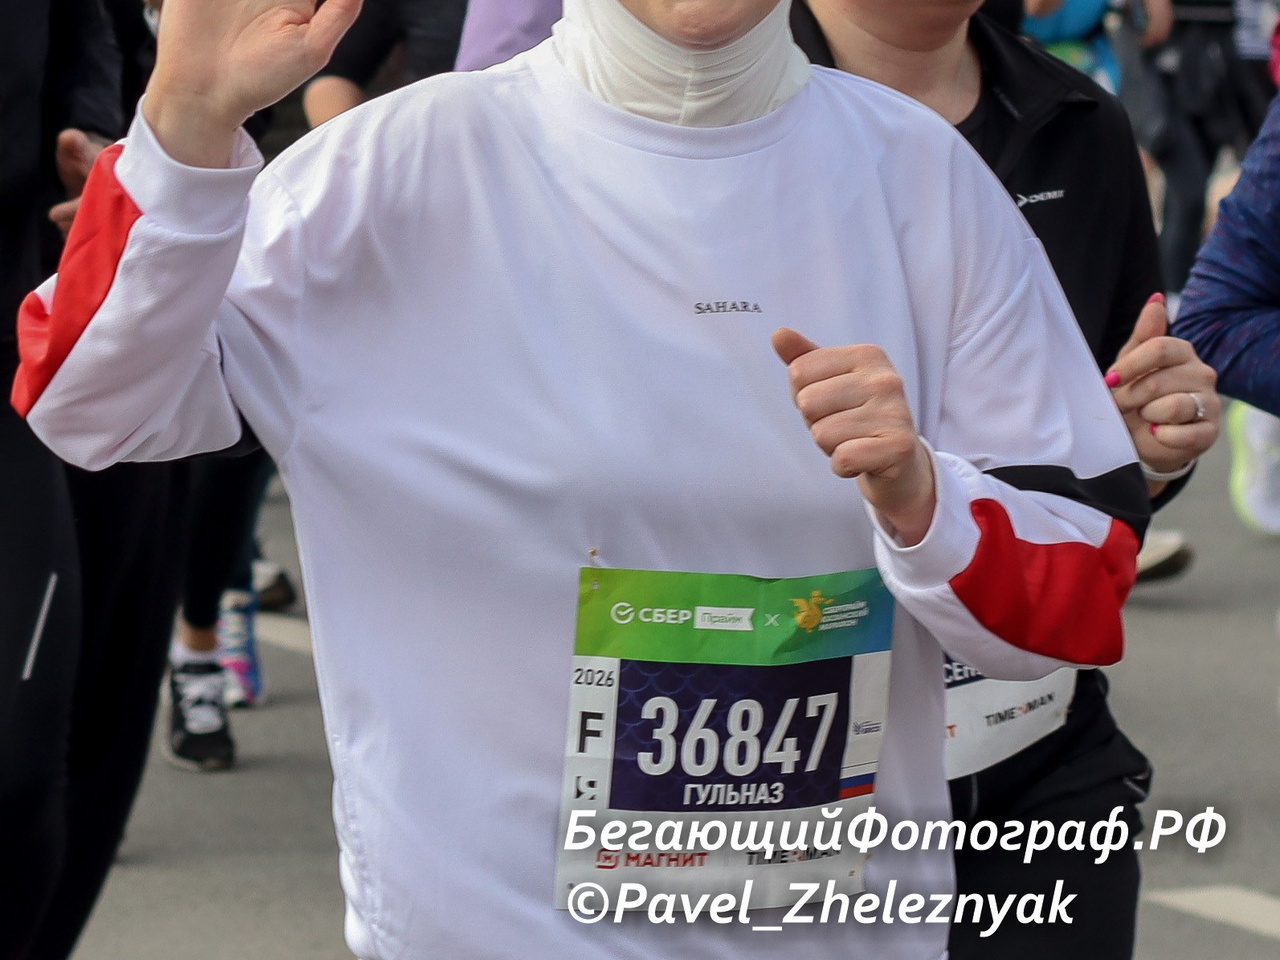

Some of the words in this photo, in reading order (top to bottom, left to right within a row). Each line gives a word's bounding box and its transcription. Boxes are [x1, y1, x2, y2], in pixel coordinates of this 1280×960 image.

[694, 301, 763, 315] SAHARA
[638, 607, 692, 624] СБЕР
[574, 668, 615, 687] 2026
[577, 711, 605, 753] F
[637, 692, 839, 776] 36847
[683, 783, 785, 806] ГУЛЬНАЗ
[624, 851, 710, 868] МАГНИТ
